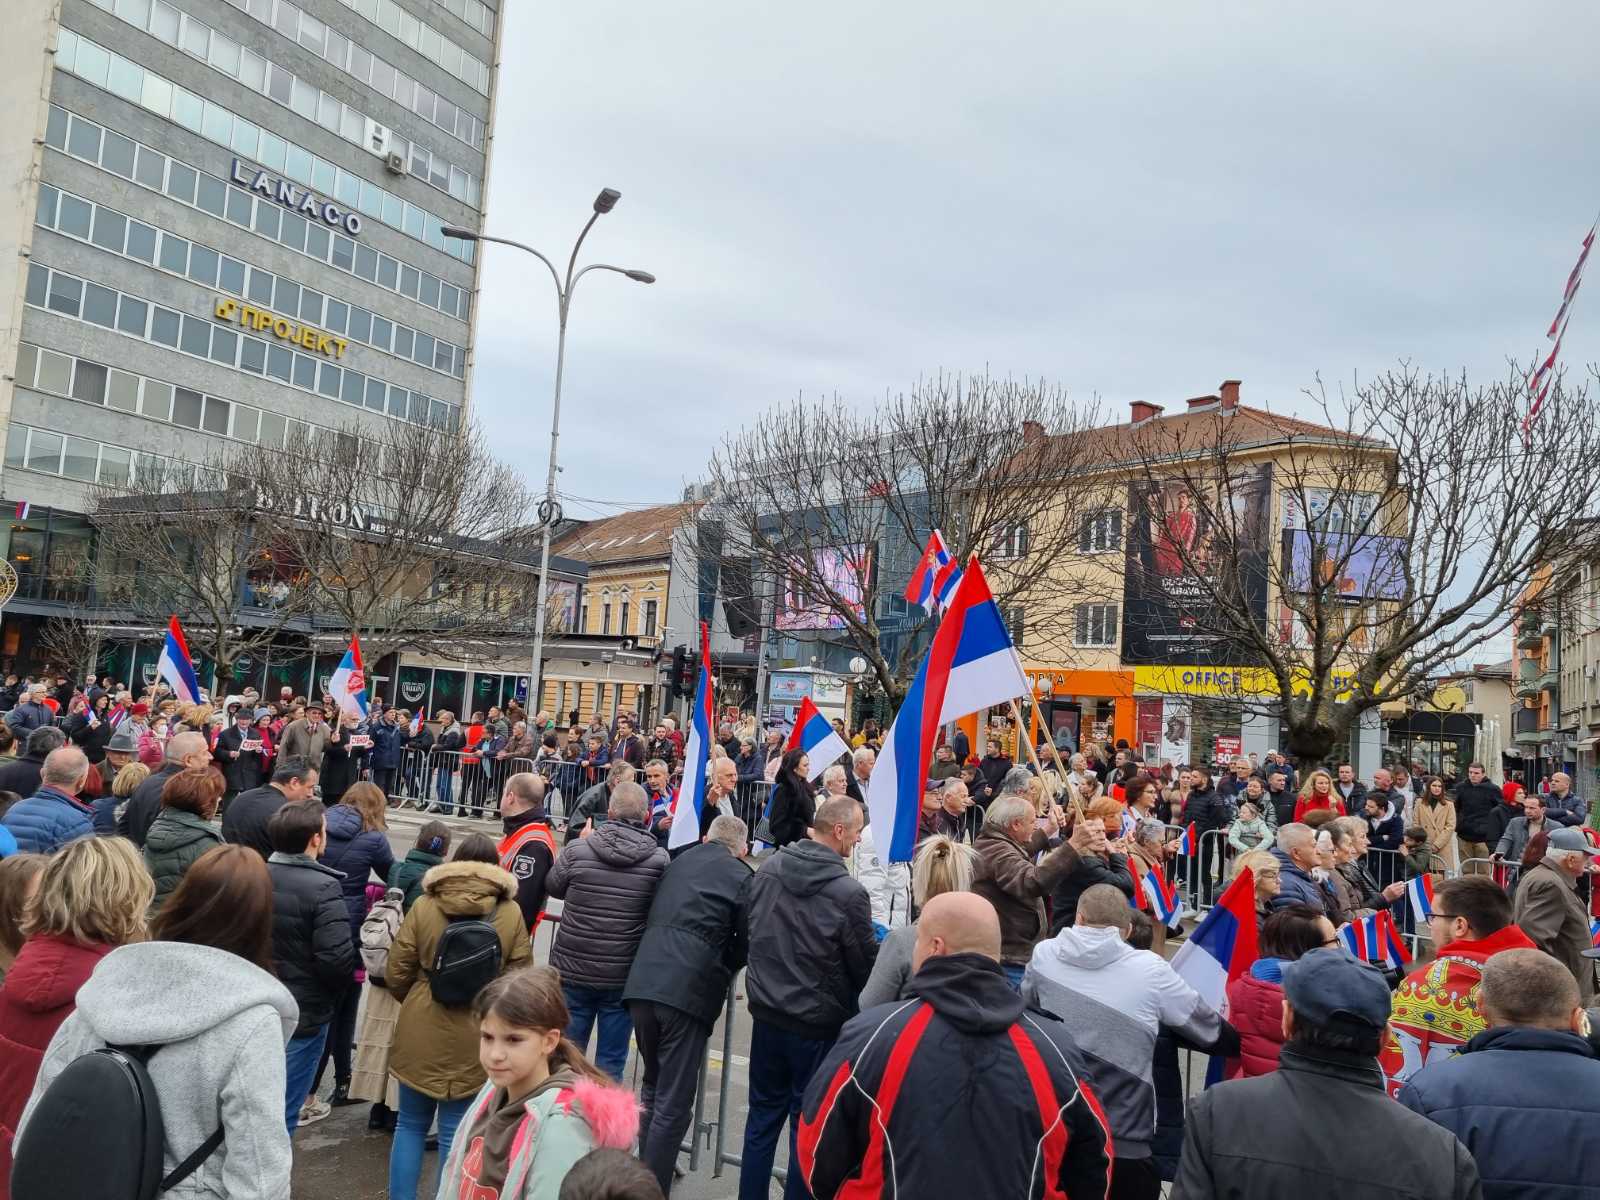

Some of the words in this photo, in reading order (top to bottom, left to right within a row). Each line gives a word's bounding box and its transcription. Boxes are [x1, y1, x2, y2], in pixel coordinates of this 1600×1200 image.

[231, 158, 362, 235] LANACO
[240, 305, 349, 359] ПРОЈЕКТ
[1181, 671, 1240, 686] OFFICE
